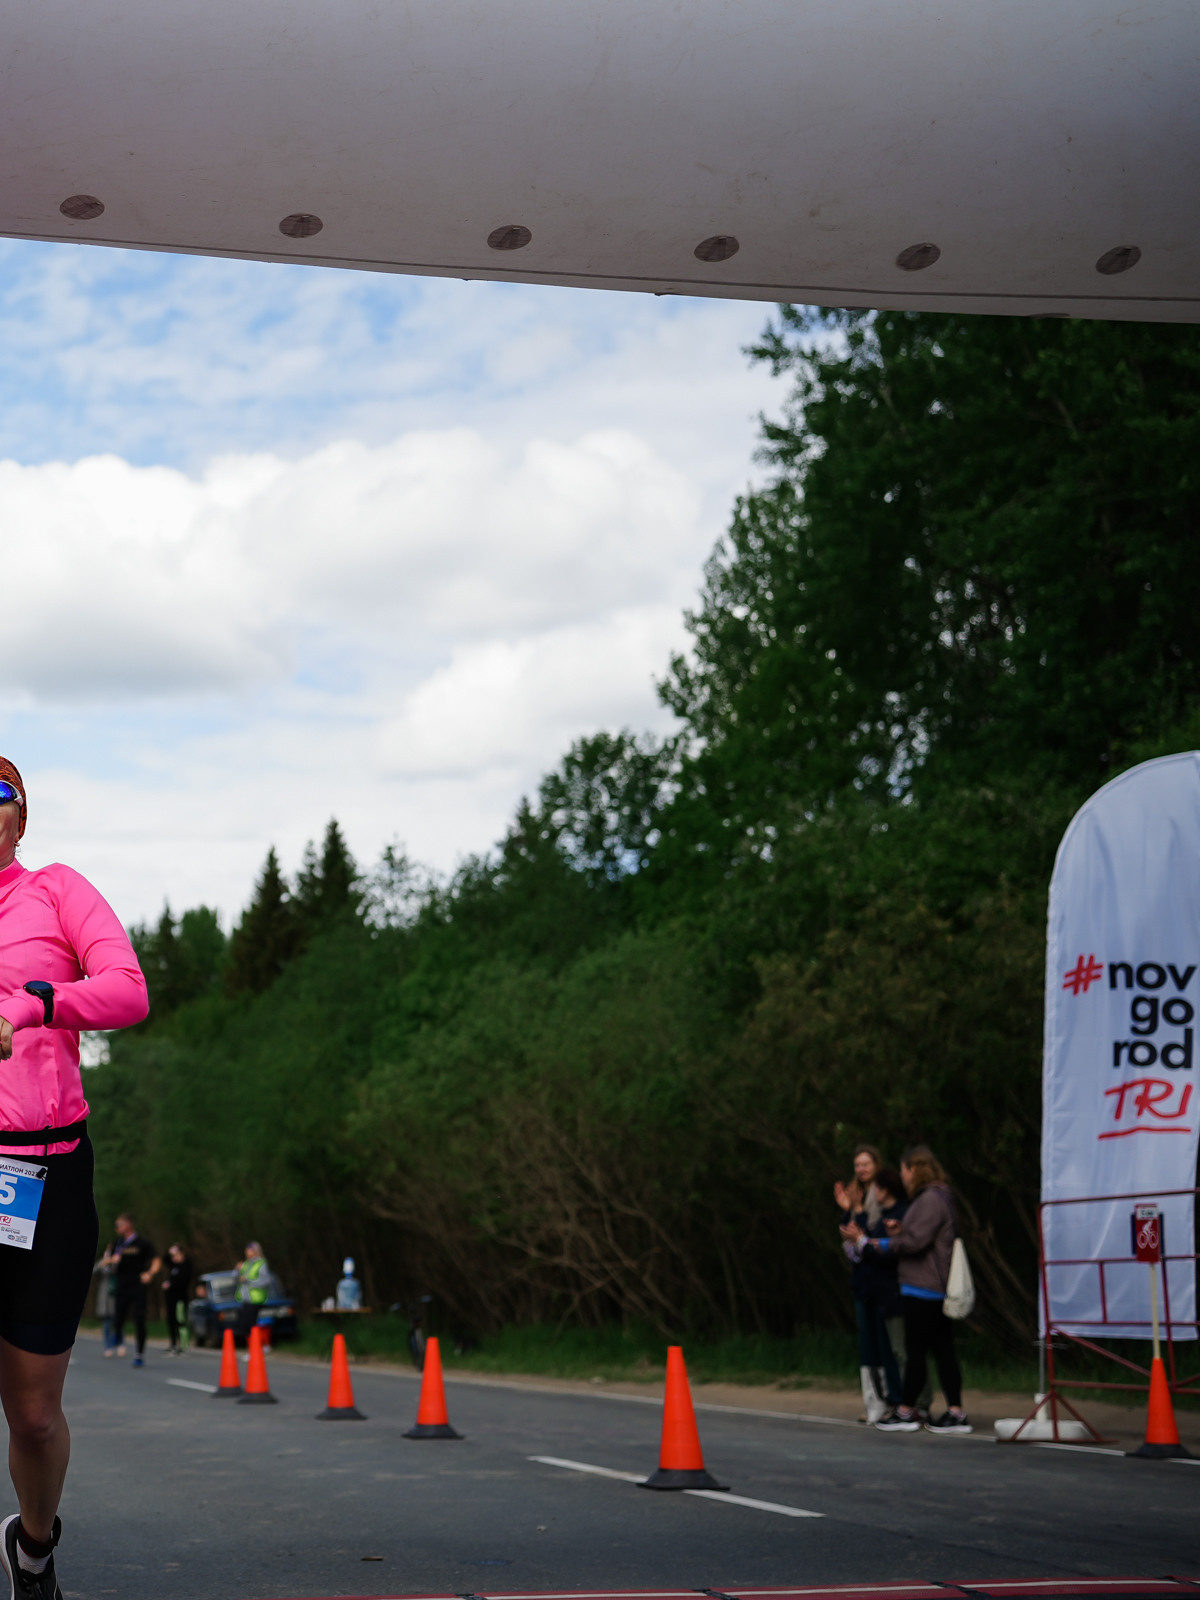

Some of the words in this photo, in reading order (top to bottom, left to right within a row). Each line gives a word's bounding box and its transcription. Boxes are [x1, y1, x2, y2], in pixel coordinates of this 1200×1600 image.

[1130, 994, 1195, 1036] go
[1113, 1028, 1193, 1069] rod
[1104, 1078, 1194, 1121] TRI
